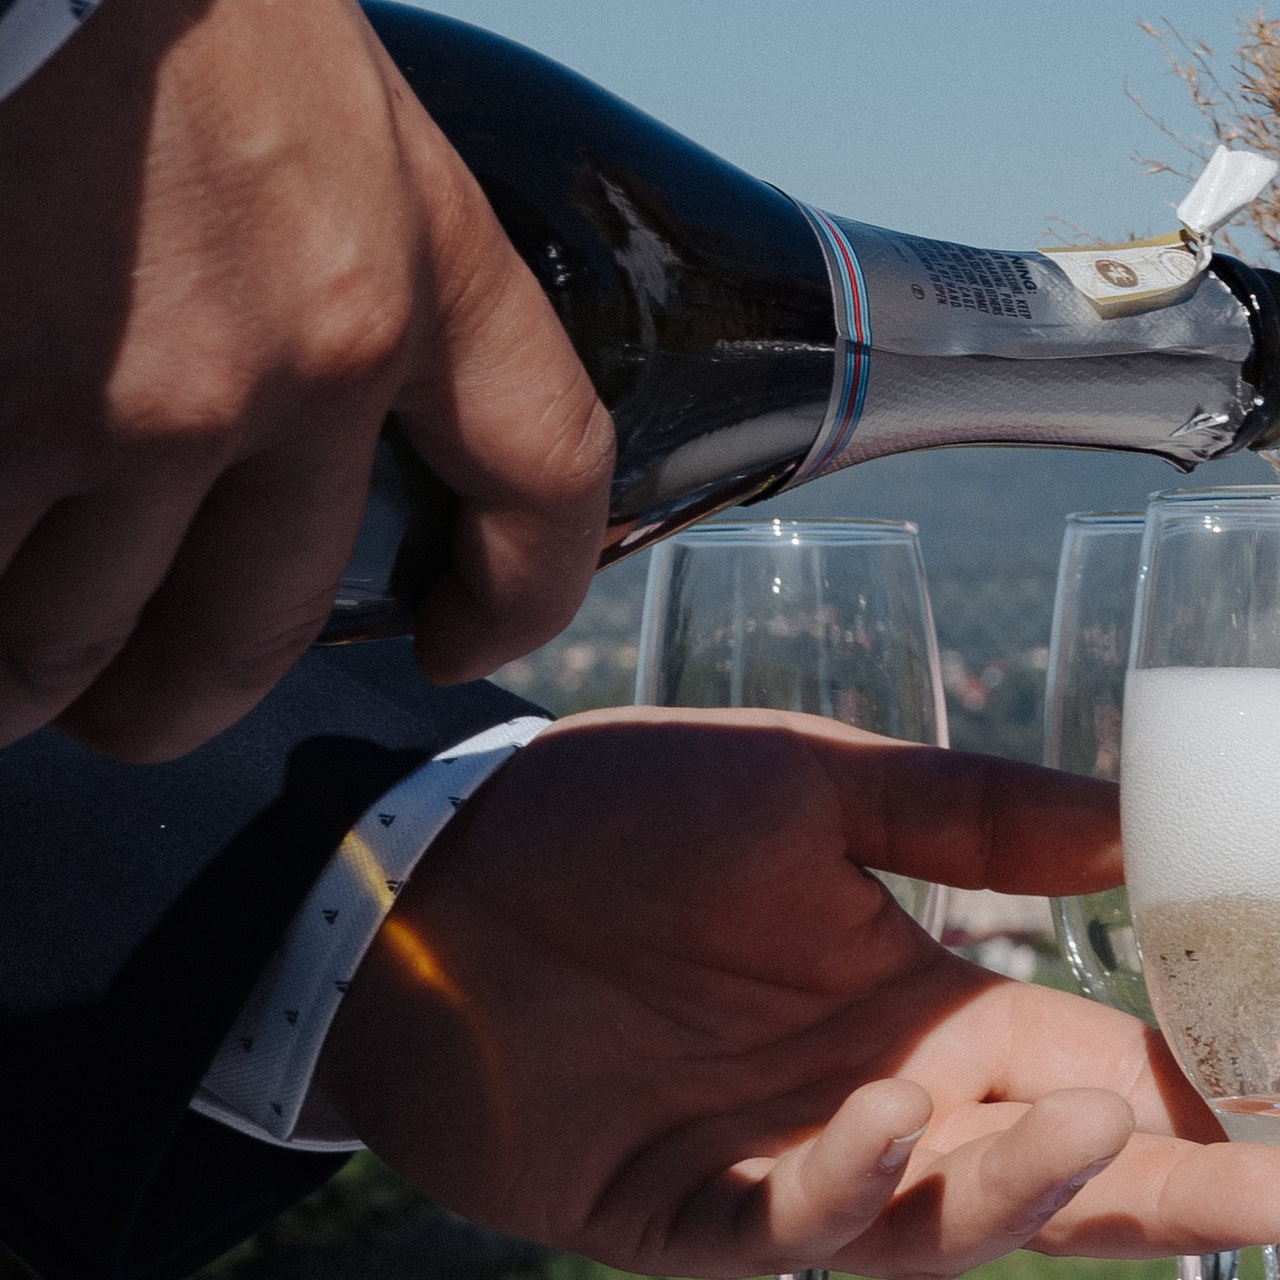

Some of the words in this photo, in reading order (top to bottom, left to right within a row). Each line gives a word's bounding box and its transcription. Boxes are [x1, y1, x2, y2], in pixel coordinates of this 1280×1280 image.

[942, 281, 963, 308] HAND
[997, 292, 1018, 317] POINT
[1015, 298, 1032, 319] KEEP
